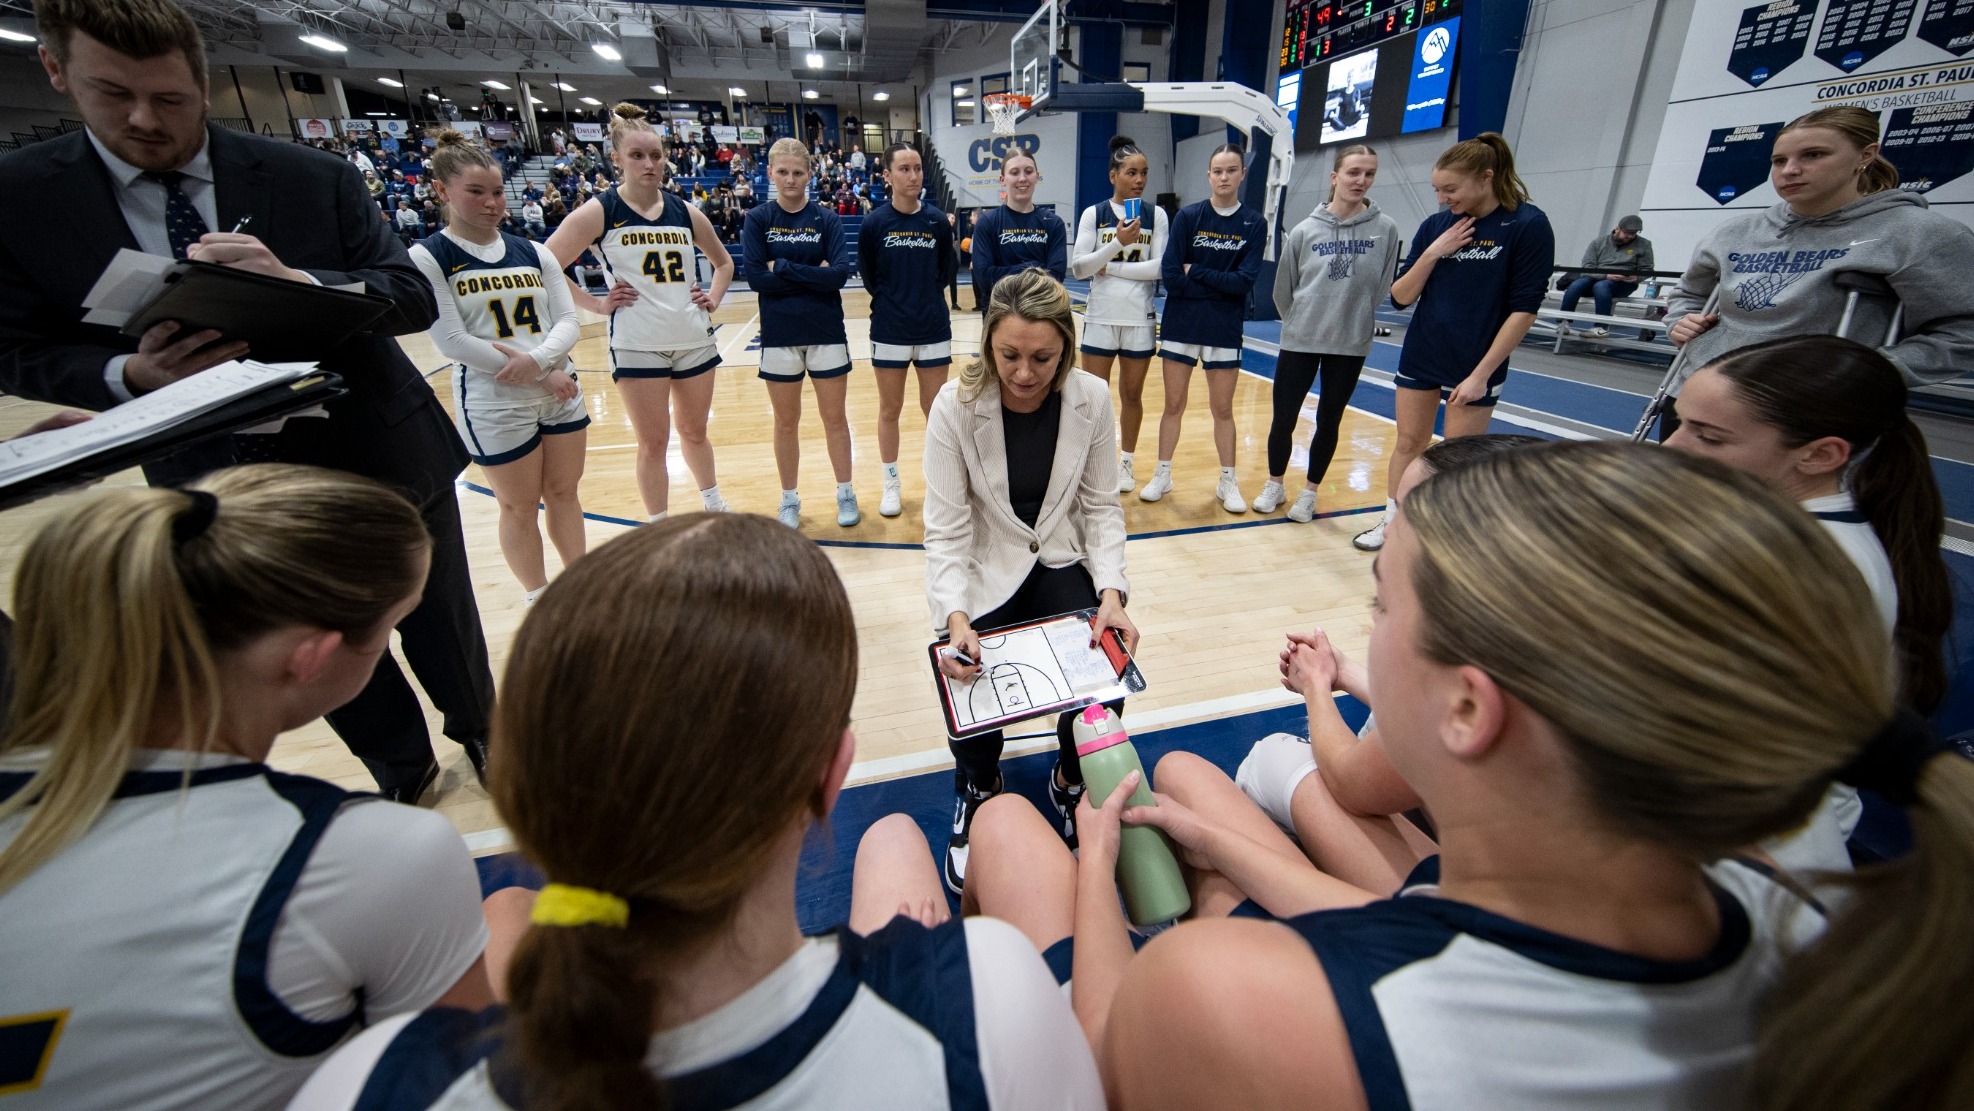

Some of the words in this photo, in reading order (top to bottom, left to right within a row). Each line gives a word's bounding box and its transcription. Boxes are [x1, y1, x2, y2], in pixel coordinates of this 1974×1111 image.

[1364, 1, 1372, 17] 3
[1424, 1, 1436, 14] 30
[1767, 0, 1795, 11] REGION
[1828, 6, 1846, 16] 2003
[1850, 1, 1870, 11] 2004
[1929, 2, 1947, 12] 2011
[1317, 7, 1331, 24] 49
[1386, 16, 1394, 32] 2
[1406, 8, 1414, 24] 2
[1757, 5, 1800, 21] CHAMPIONS
[1825, 14, 1844, 24] 2007
[1870, 4, 1890, 14] 2009
[1926, 11, 1946, 22] 2016
[1952, 6, 1973, 16] 2017
[1776, 18, 1792, 26] 2007
[1822, 24, 1838, 33] 2011
[1868, 14, 1885, 24] 2013
[1892, 9, 1911, 19] 2014
[1864, 24, 1882, 33] 2017
[1324, 40, 1330, 54] 3
[1818, 76, 1904, 99] CONCORDIA
[1908, 73, 1930, 88] ST.
[1882, 88, 1956, 108] BASKETBALL
[1912, 101, 1974, 116] CONFERENCE
[1911, 110, 1971, 124] CHAMPIONS
[1256, 115, 1275, 134] SPALDING
[1920, 124, 1954, 134] 2006-07
[1724, 132, 1764, 142] CHAMPIONS
[968, 133, 1041, 173] CSP
[1899, 180, 1934, 190] NSIC
[621, 232, 690, 246] CONCORDIA
[765, 230, 822, 244] Basketball
[884, 236, 937, 249] Basketball
[998, 233, 1048, 244] Basketball
[1101, 232, 1152, 244] CODIA
[1192, 236, 1247, 250] Basketball
[1442, 246, 1503, 262] ketball
[1728, 251, 1790, 264] GOLDEN
[1792, 248, 1850, 262] BEARS
[641, 249, 686, 284] 42
[1732, 261, 1824, 274] BASKETBALL
[487, 295, 543, 339] 14
